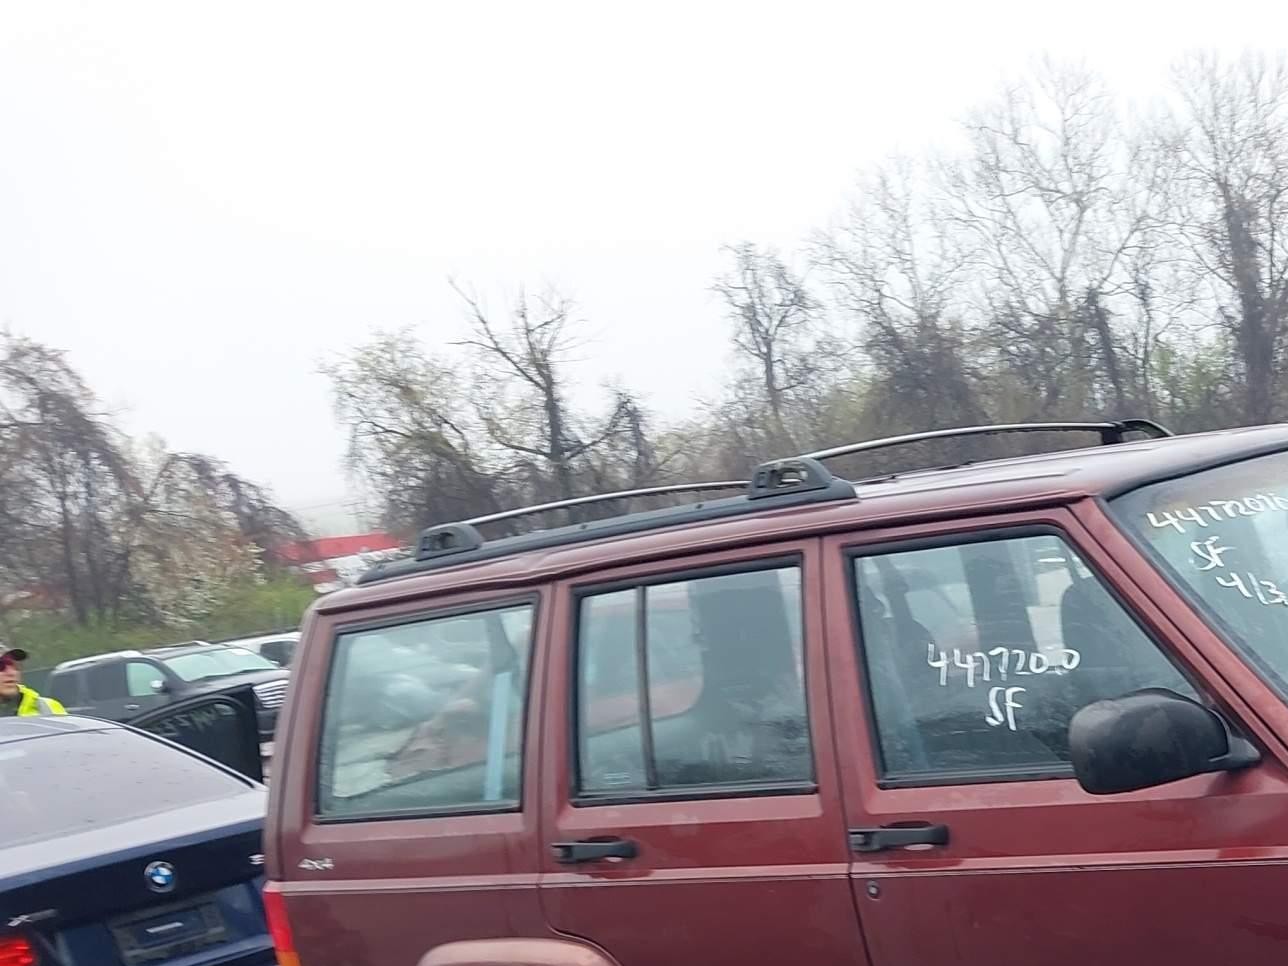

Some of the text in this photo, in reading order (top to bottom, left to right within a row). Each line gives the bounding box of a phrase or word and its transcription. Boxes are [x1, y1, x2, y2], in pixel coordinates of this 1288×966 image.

[1190, 536, 1236, 570] SF
[927, 643, 1081, 687] 4477200
[985, 686, 1026, 731] SF
